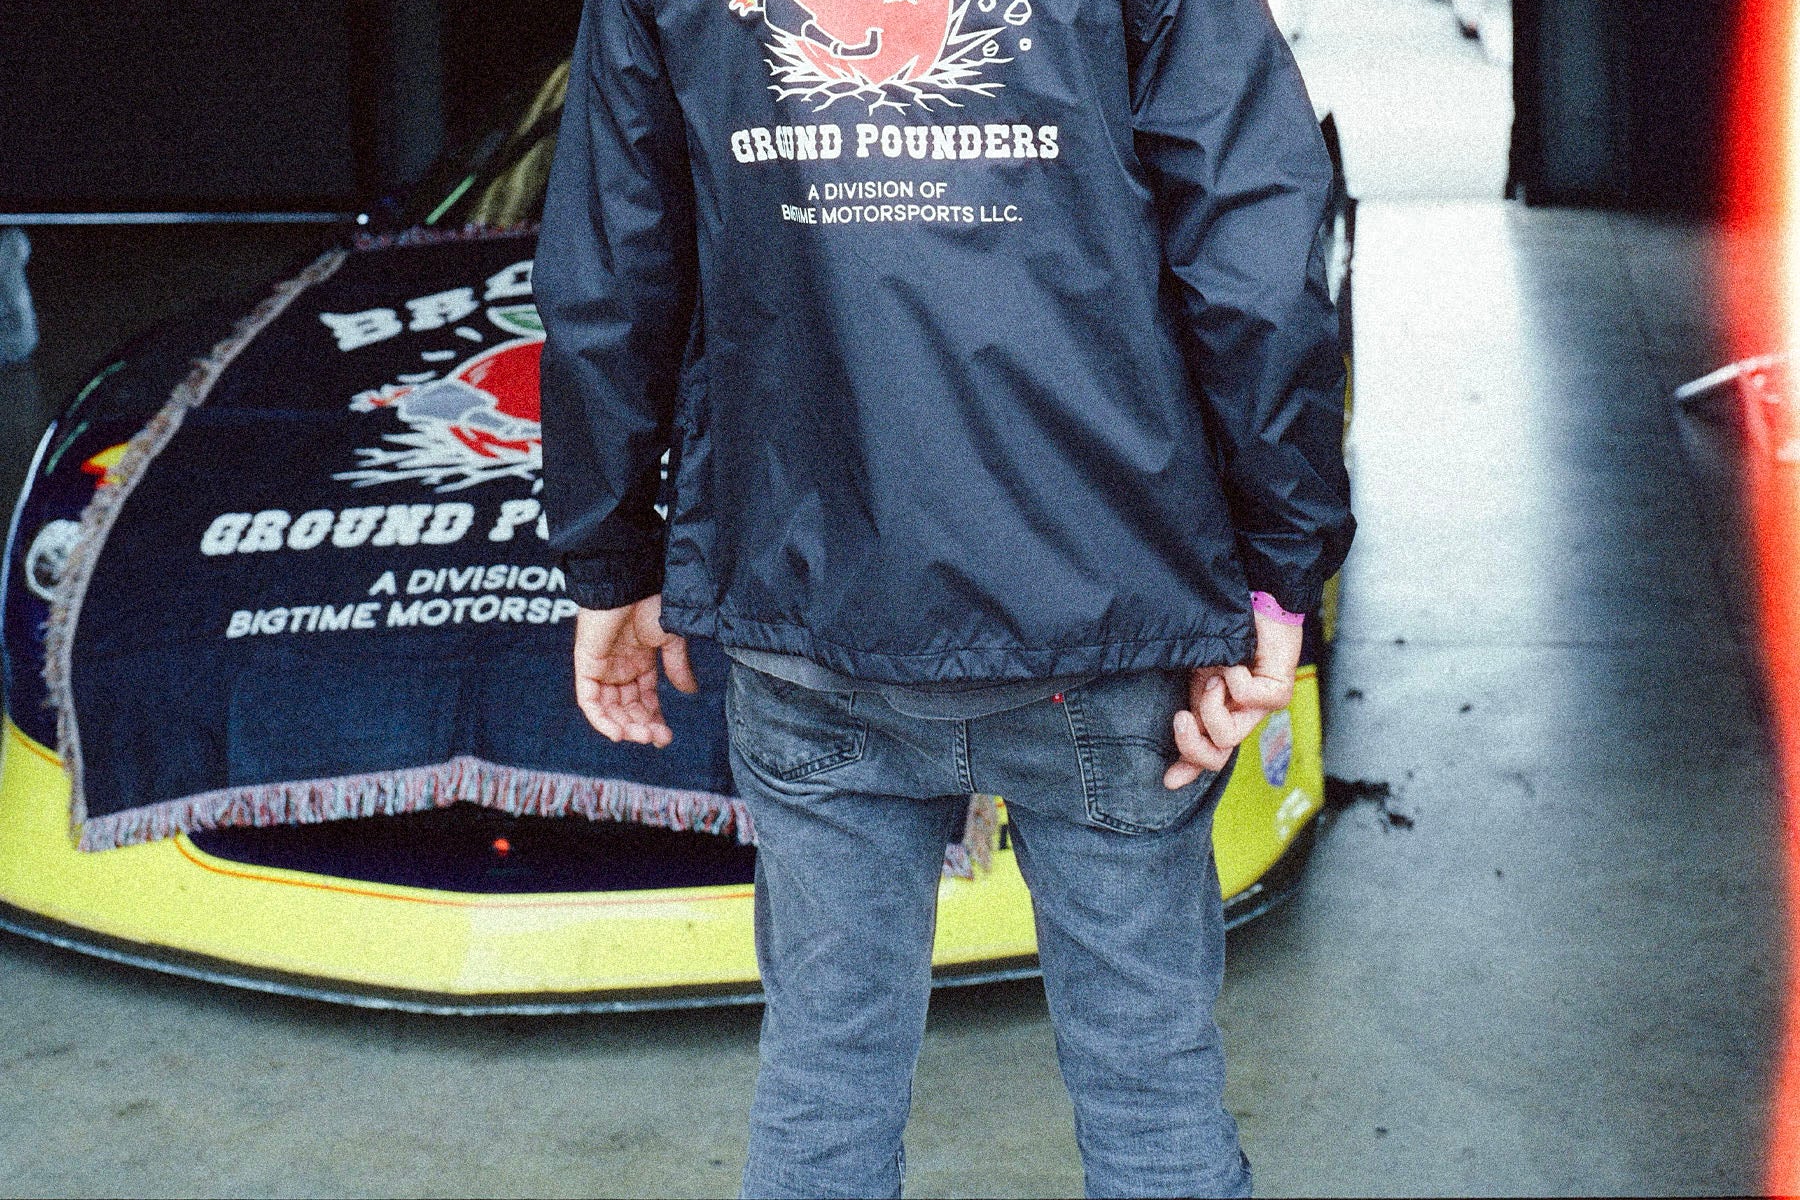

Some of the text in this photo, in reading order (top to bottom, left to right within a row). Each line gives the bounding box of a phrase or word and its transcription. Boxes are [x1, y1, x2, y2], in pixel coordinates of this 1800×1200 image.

[854, 123, 1060, 163] POUNDERS
[807, 180, 949, 201] A DIVISION OF
[821, 203, 975, 225] MOTORSPORTS
[979, 203, 1024, 224] LLC.
[199, 502, 475, 557] GROUND
[368, 570, 397, 597] A
[224, 601, 381, 640] BIGTIME
